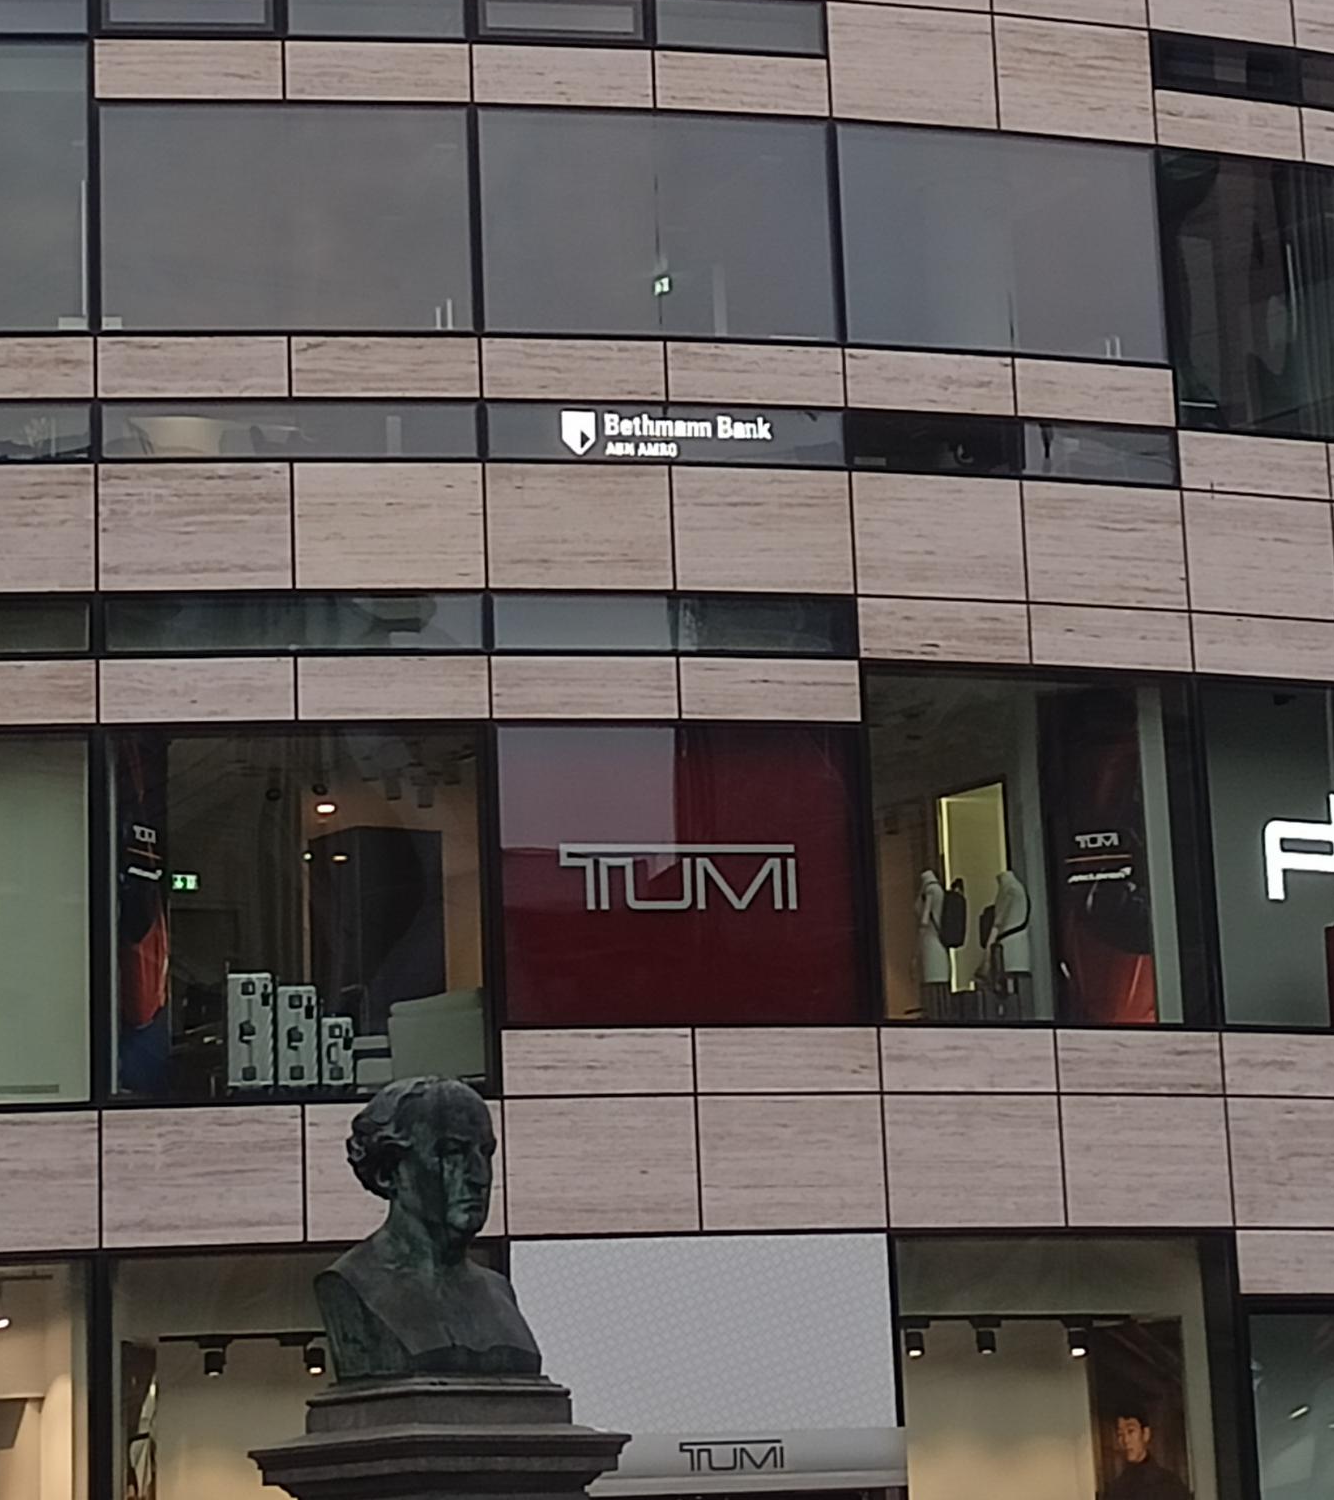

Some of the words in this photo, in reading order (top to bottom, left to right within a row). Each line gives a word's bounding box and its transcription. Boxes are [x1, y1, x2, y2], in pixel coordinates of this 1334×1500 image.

[603, 412, 713, 438] Bethmann
[716, 414, 773, 440] Bank
[559, 842, 799, 910] TUMI
[679, 1439, 785, 1472] TUMI
